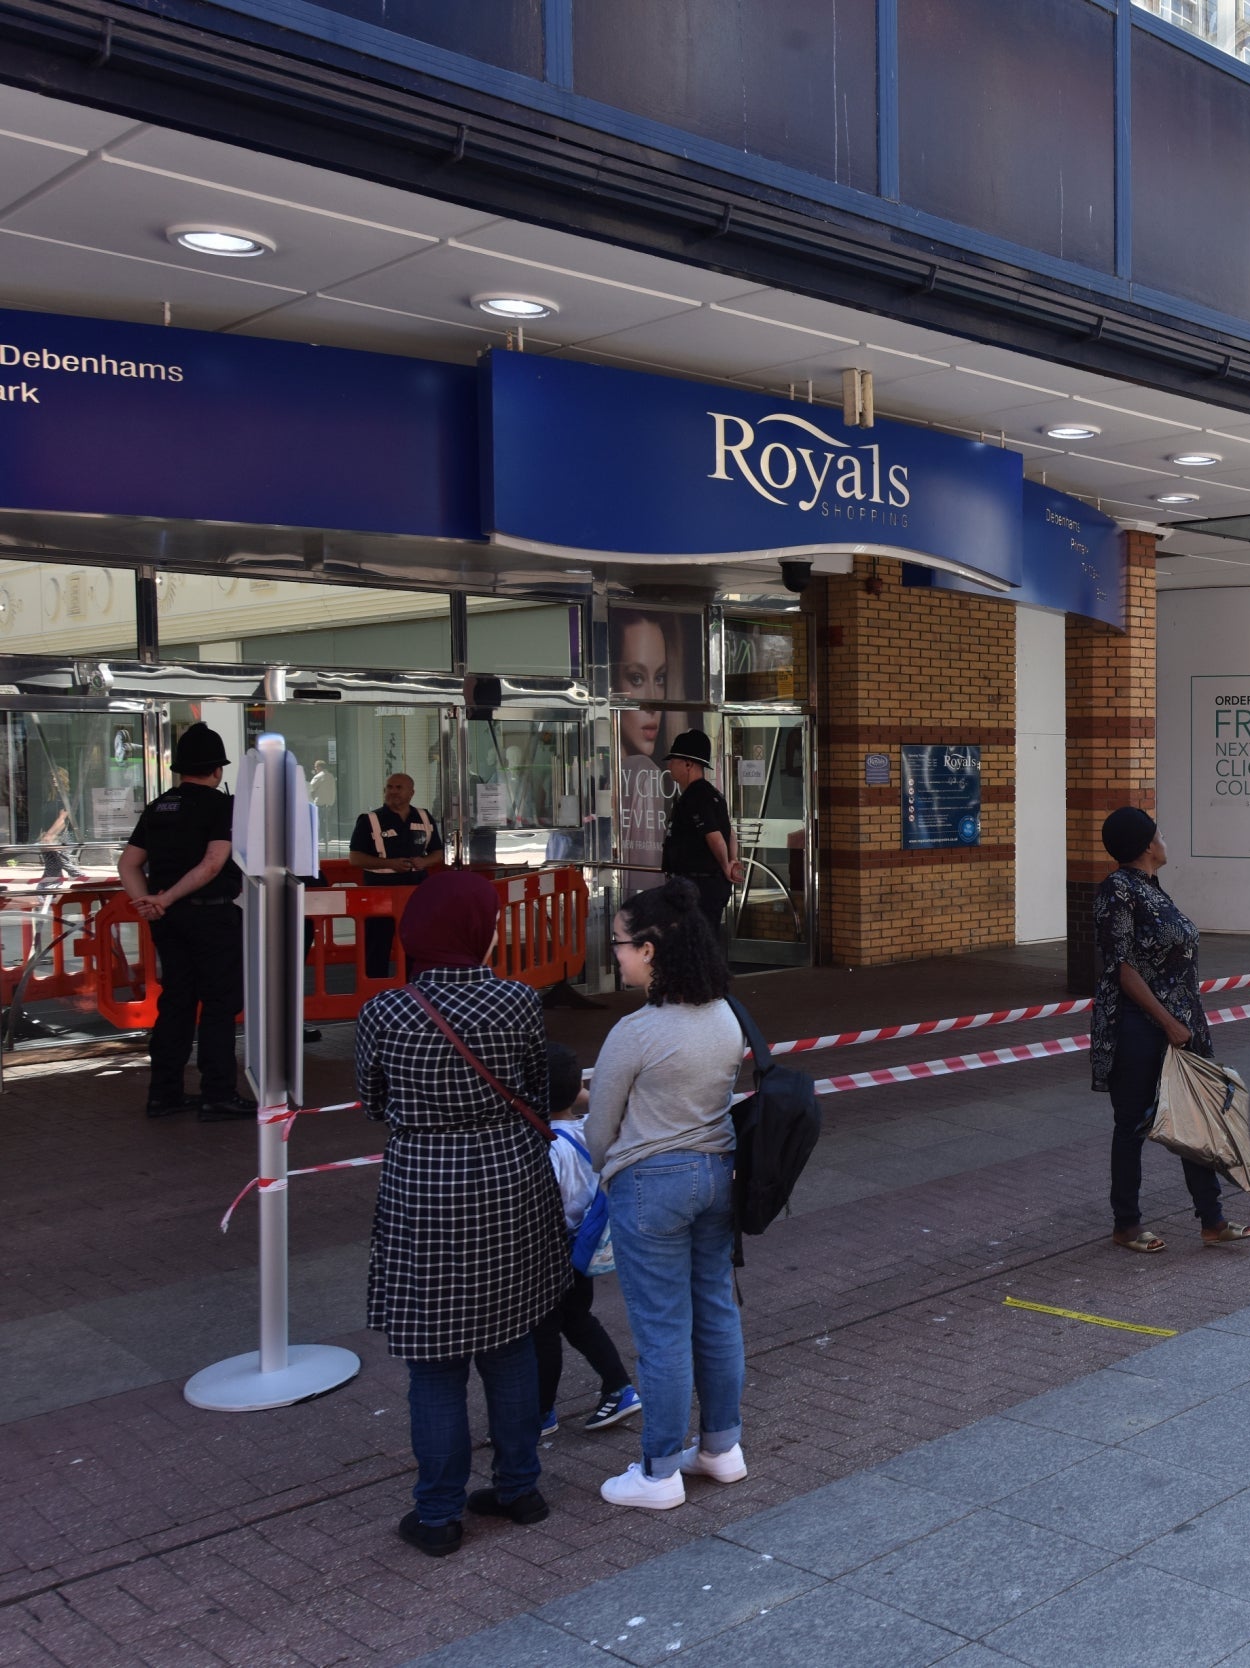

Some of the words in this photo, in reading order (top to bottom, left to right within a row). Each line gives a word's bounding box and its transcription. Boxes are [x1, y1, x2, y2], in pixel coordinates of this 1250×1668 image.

[0, 344, 184, 382] Debenhams
[706, 411, 910, 511] Royals
[821, 501, 910, 528] SHOPPING
[1046, 508, 1081, 533] Debenhams
[944, 753, 977, 770] Royals
[156, 803, 181, 812] POLICE
